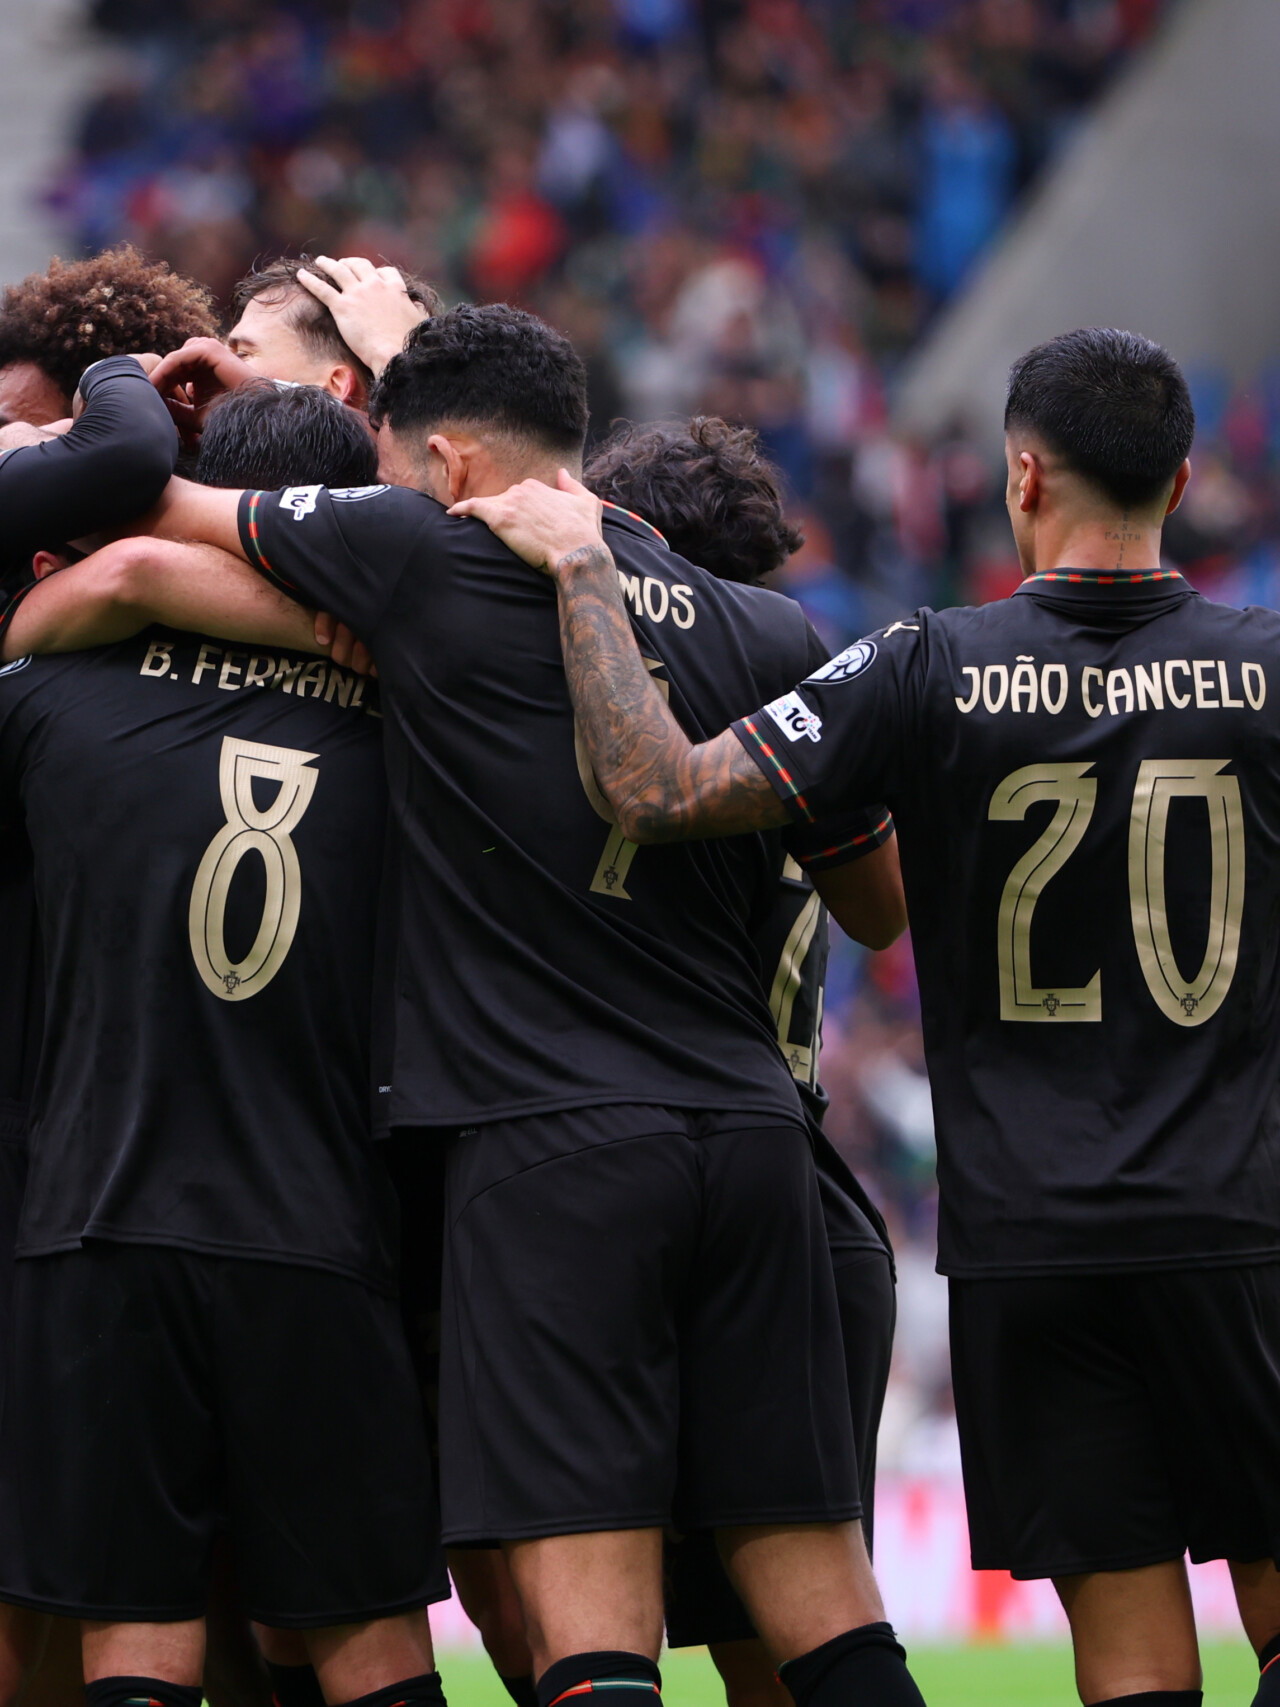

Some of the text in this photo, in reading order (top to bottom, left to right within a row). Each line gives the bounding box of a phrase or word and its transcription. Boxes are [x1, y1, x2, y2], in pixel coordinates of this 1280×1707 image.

[619, 570, 696, 629] MOS
[140, 640, 383, 717] B. FERNAN
[955, 656, 1266, 718] JOÃO CANCELO
[189, 736, 320, 1001] 8
[987, 759, 1246, 1027] 20
